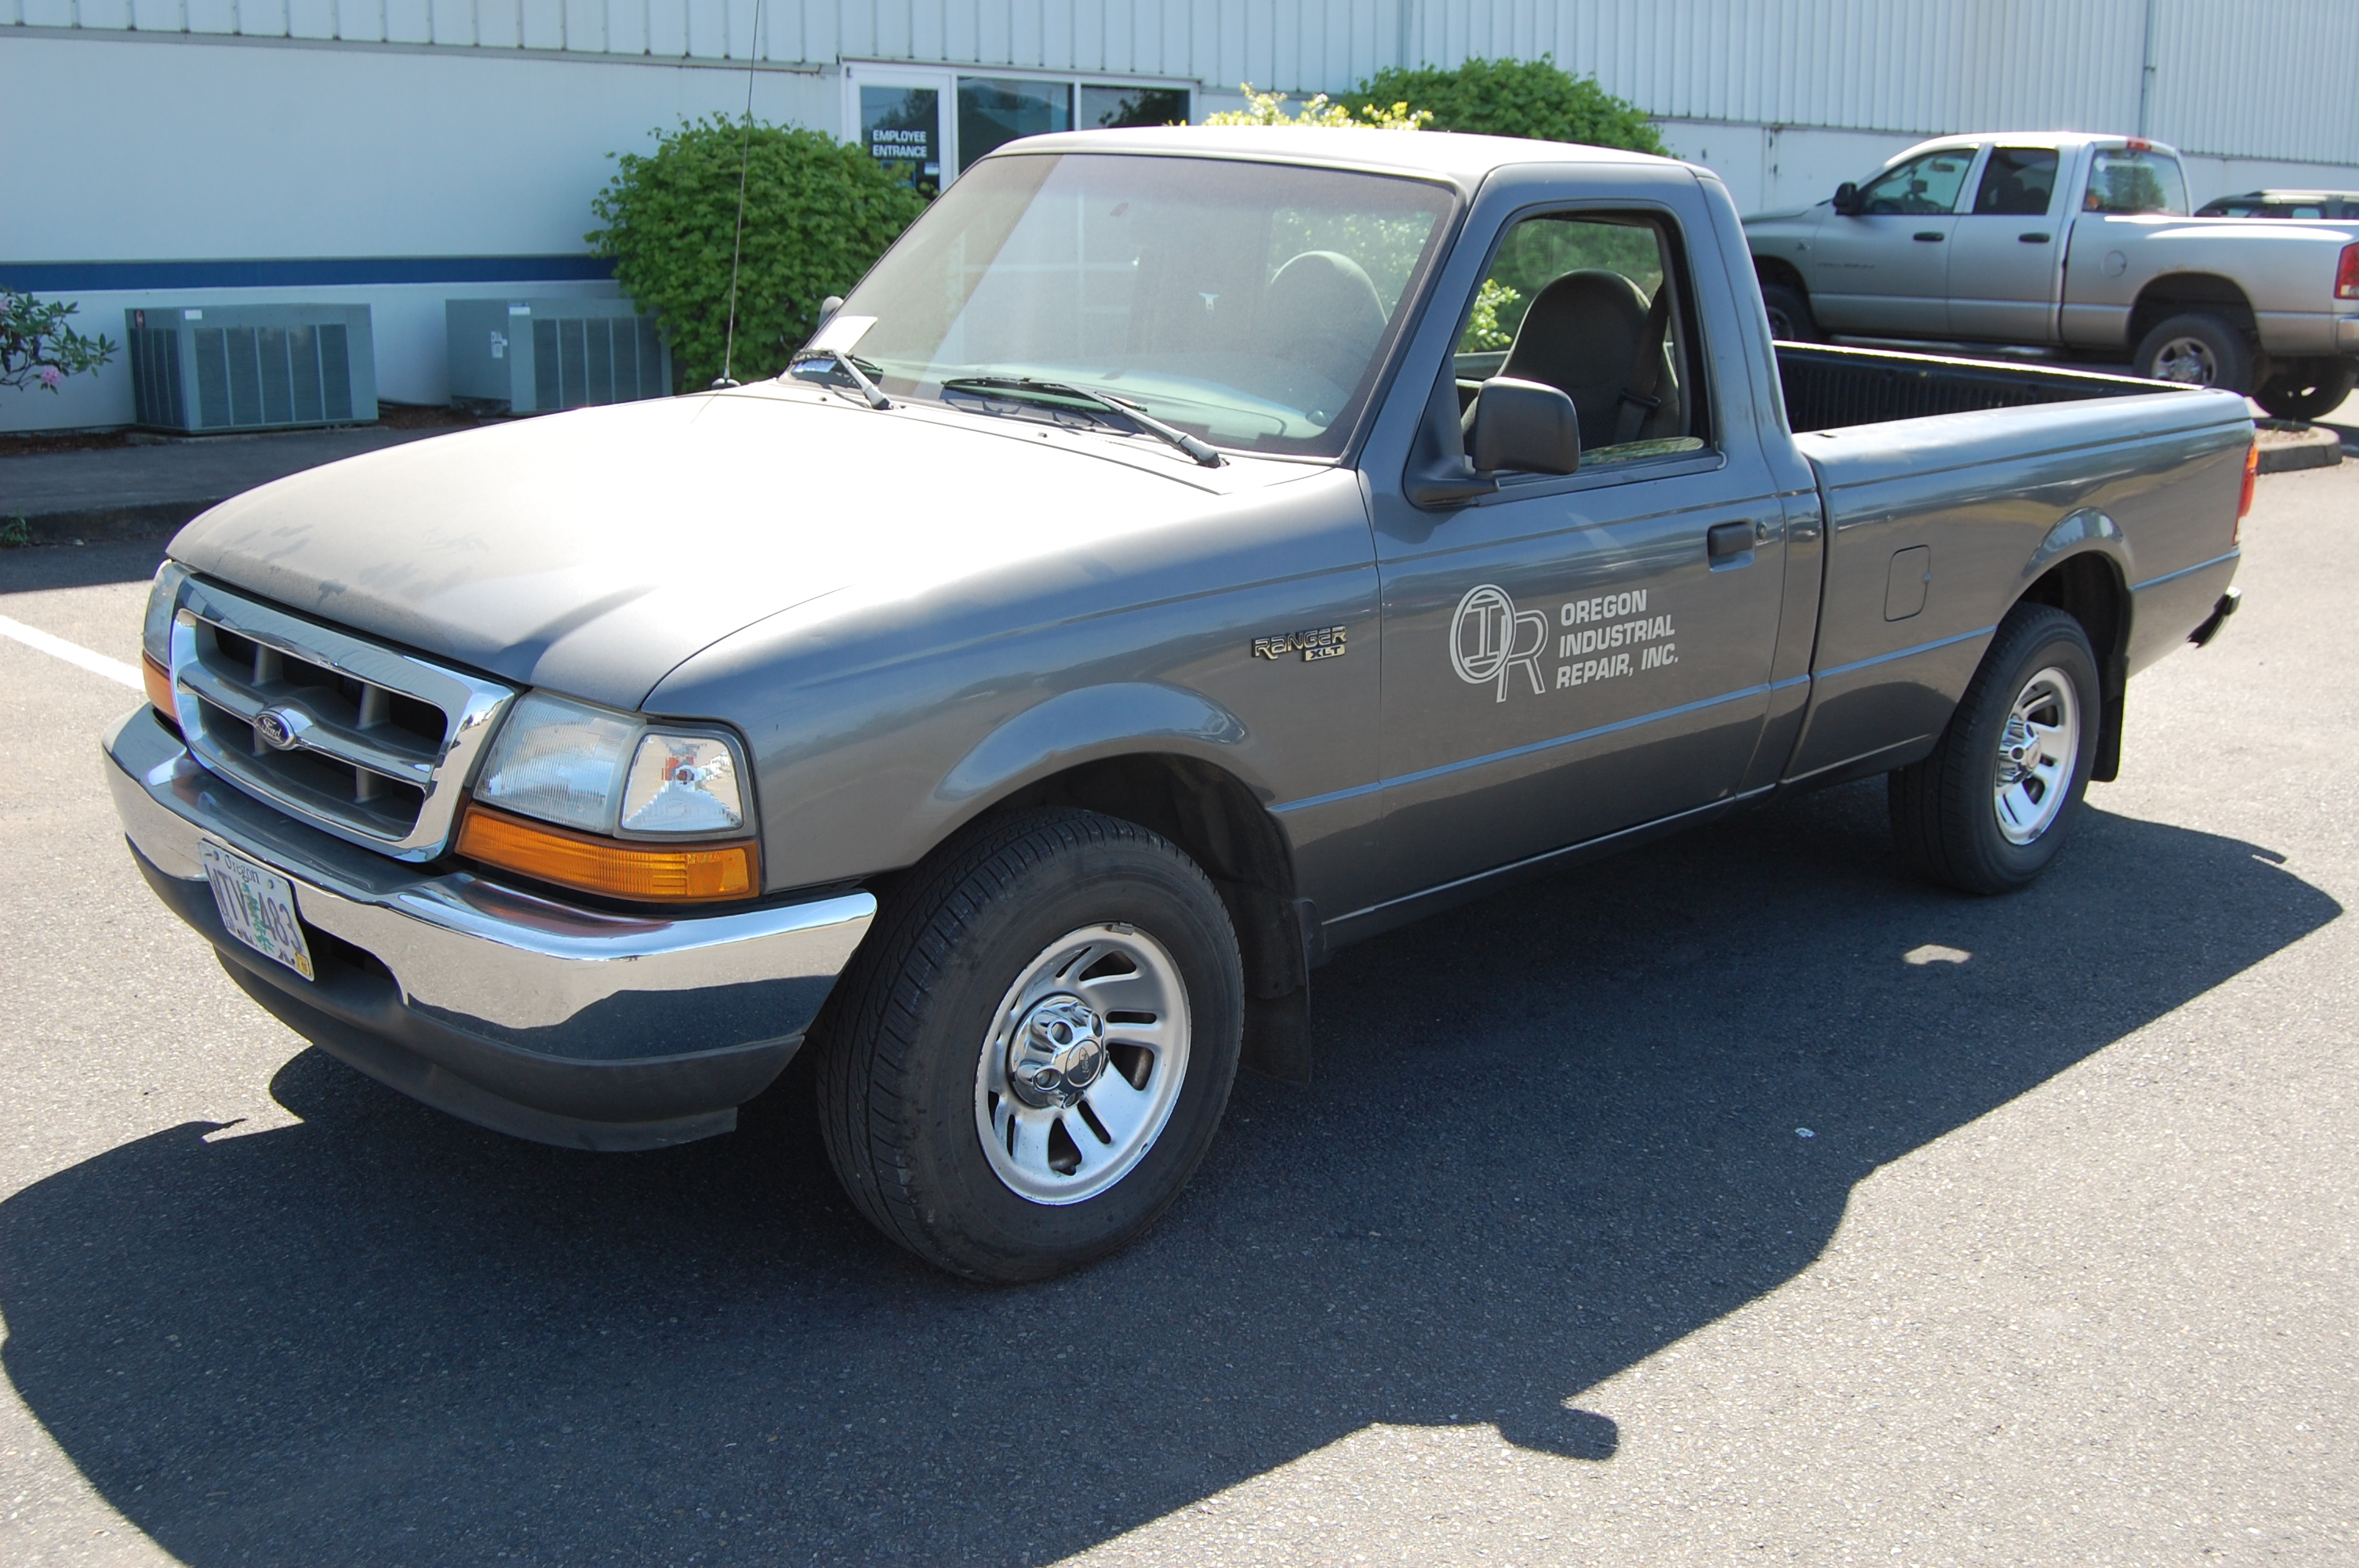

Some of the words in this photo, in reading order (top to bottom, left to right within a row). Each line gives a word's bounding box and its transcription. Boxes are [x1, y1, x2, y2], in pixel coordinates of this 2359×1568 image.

[873, 129, 926, 143] EMPLOYEE
[873, 144, 927, 158] ENTRANCE
[1561, 589, 1647, 626] OREGON
[1252, 625, 1347, 660] RANGER
[1559, 614, 1676, 658] INDUSTRIAL
[1310, 646, 1342, 659] XLT
[1556, 653, 1634, 689] REPAIR,
[1641, 643, 1679, 670] INC.
[262, 717, 282, 739] Ford
[224, 855, 260, 885] Oregon
[258, 891, 303, 954] 483
